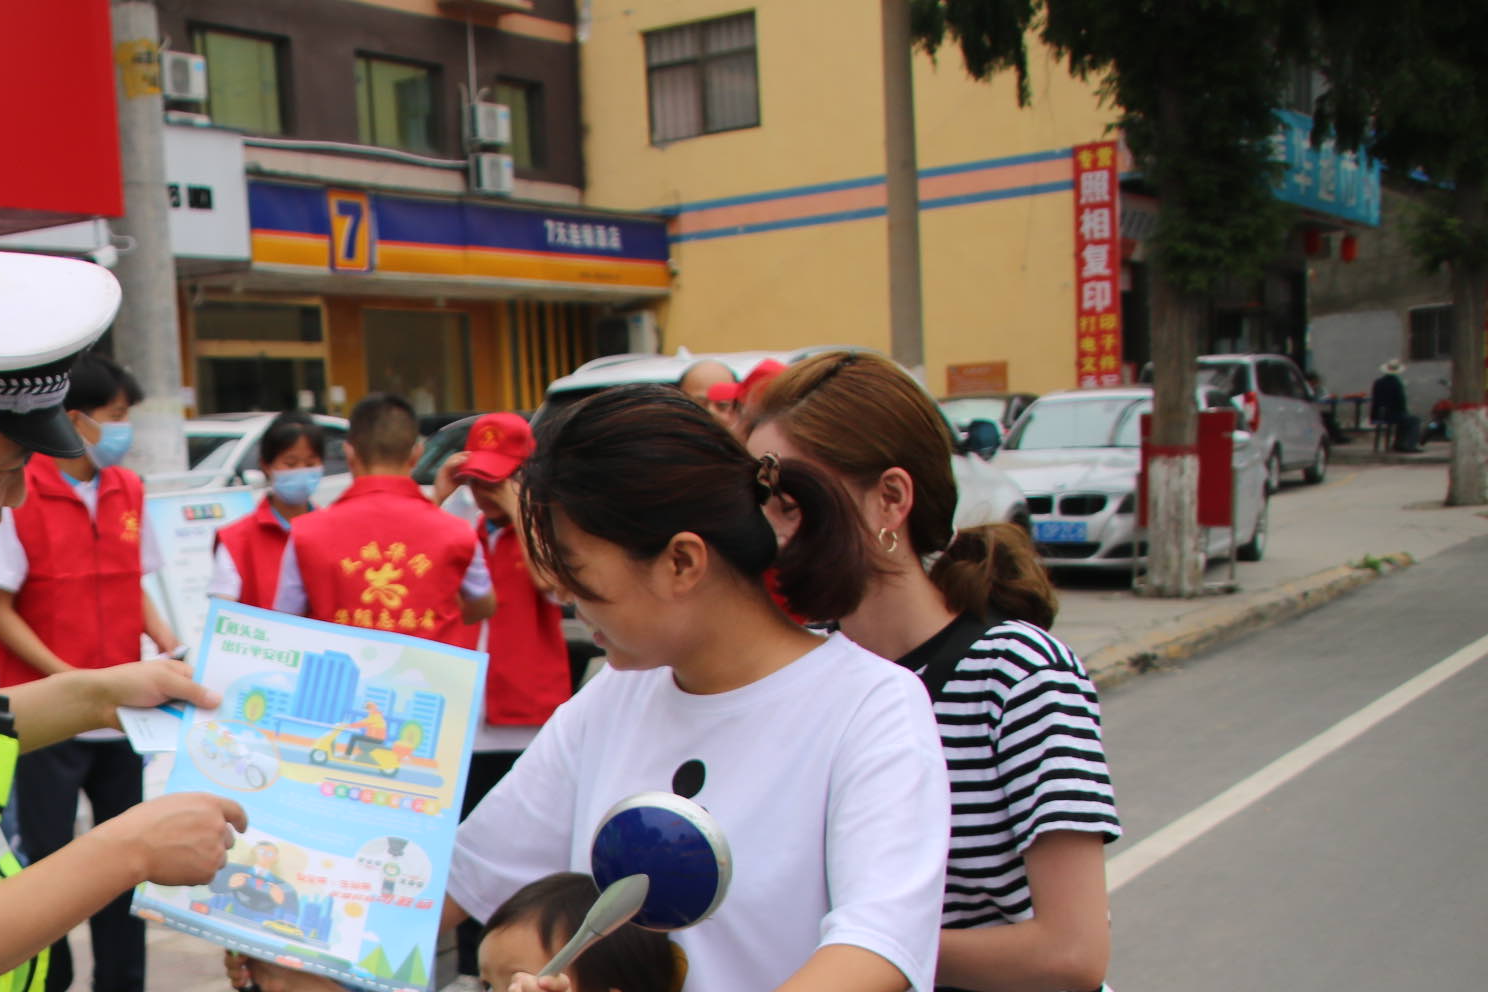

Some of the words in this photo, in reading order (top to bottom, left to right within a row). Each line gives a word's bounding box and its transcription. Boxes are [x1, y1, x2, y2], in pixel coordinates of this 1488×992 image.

[338, 201, 365, 260] 7
[1079, 170, 1112, 313] 照相复印
